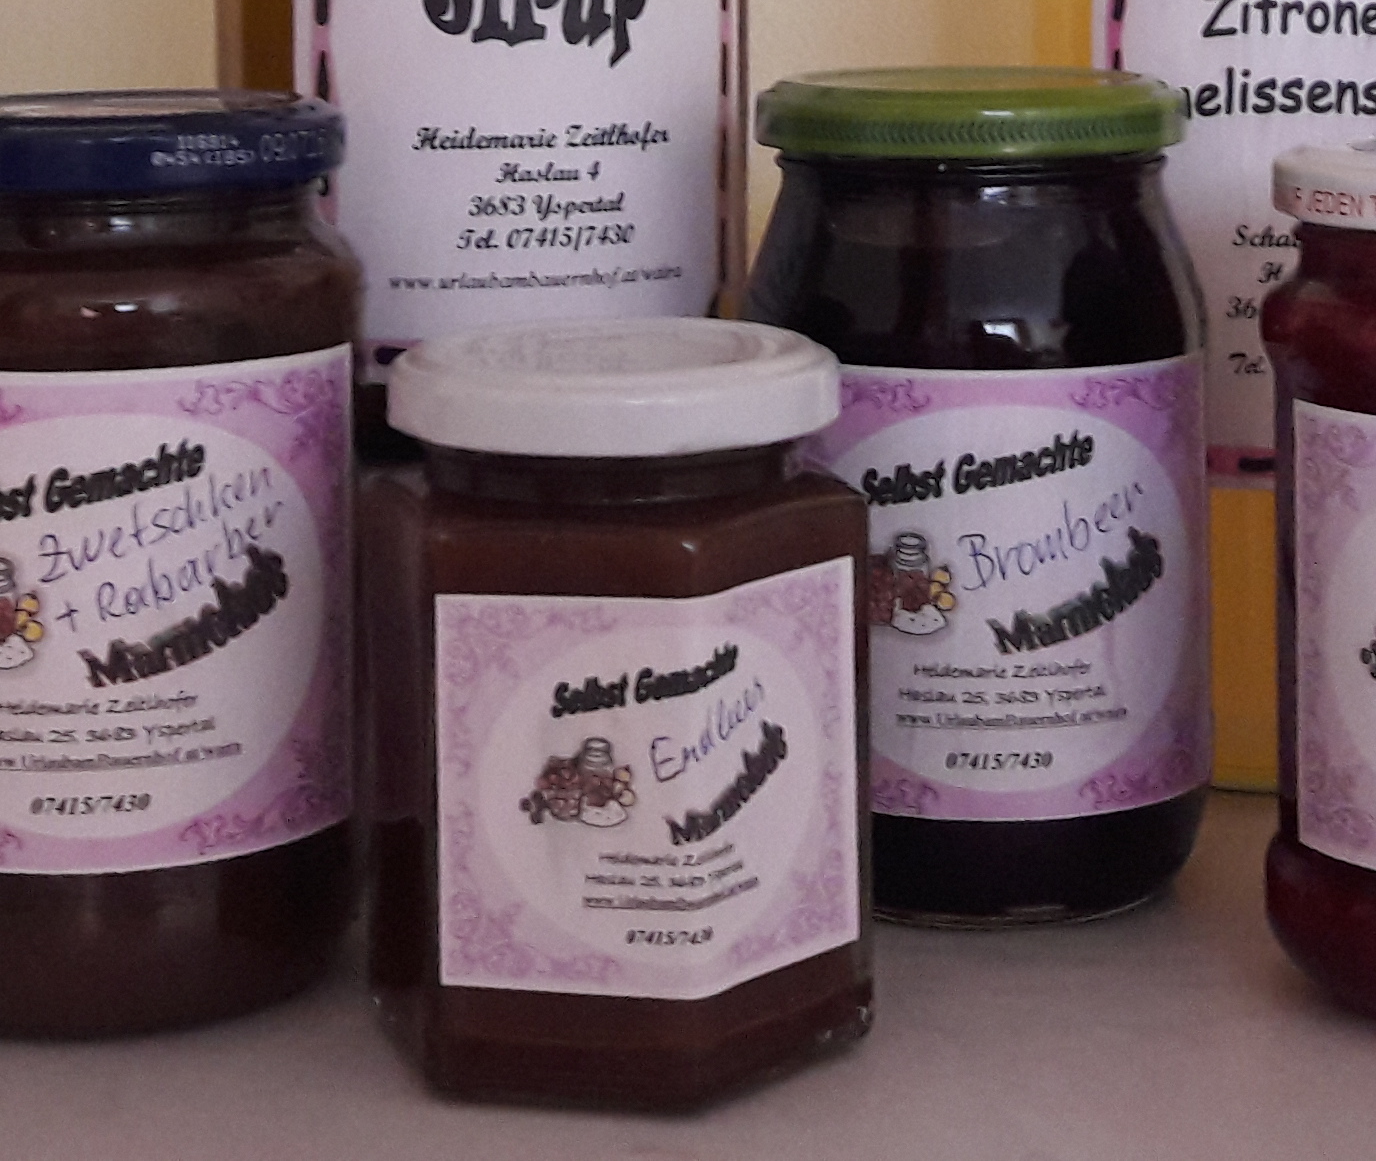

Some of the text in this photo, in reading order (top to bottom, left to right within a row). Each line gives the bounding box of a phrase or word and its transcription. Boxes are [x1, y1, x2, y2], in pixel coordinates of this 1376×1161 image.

[411, 126, 558, 150] Heidemarie
[495, 160, 602, 183] Haslau 4
[1305, 186, 1363, 218] JEDEN
[44, 440, 205, 513] Gemachte
[862, 429, 1094, 506] Selbst Gemachte
[55, 600, 80, 632] +
